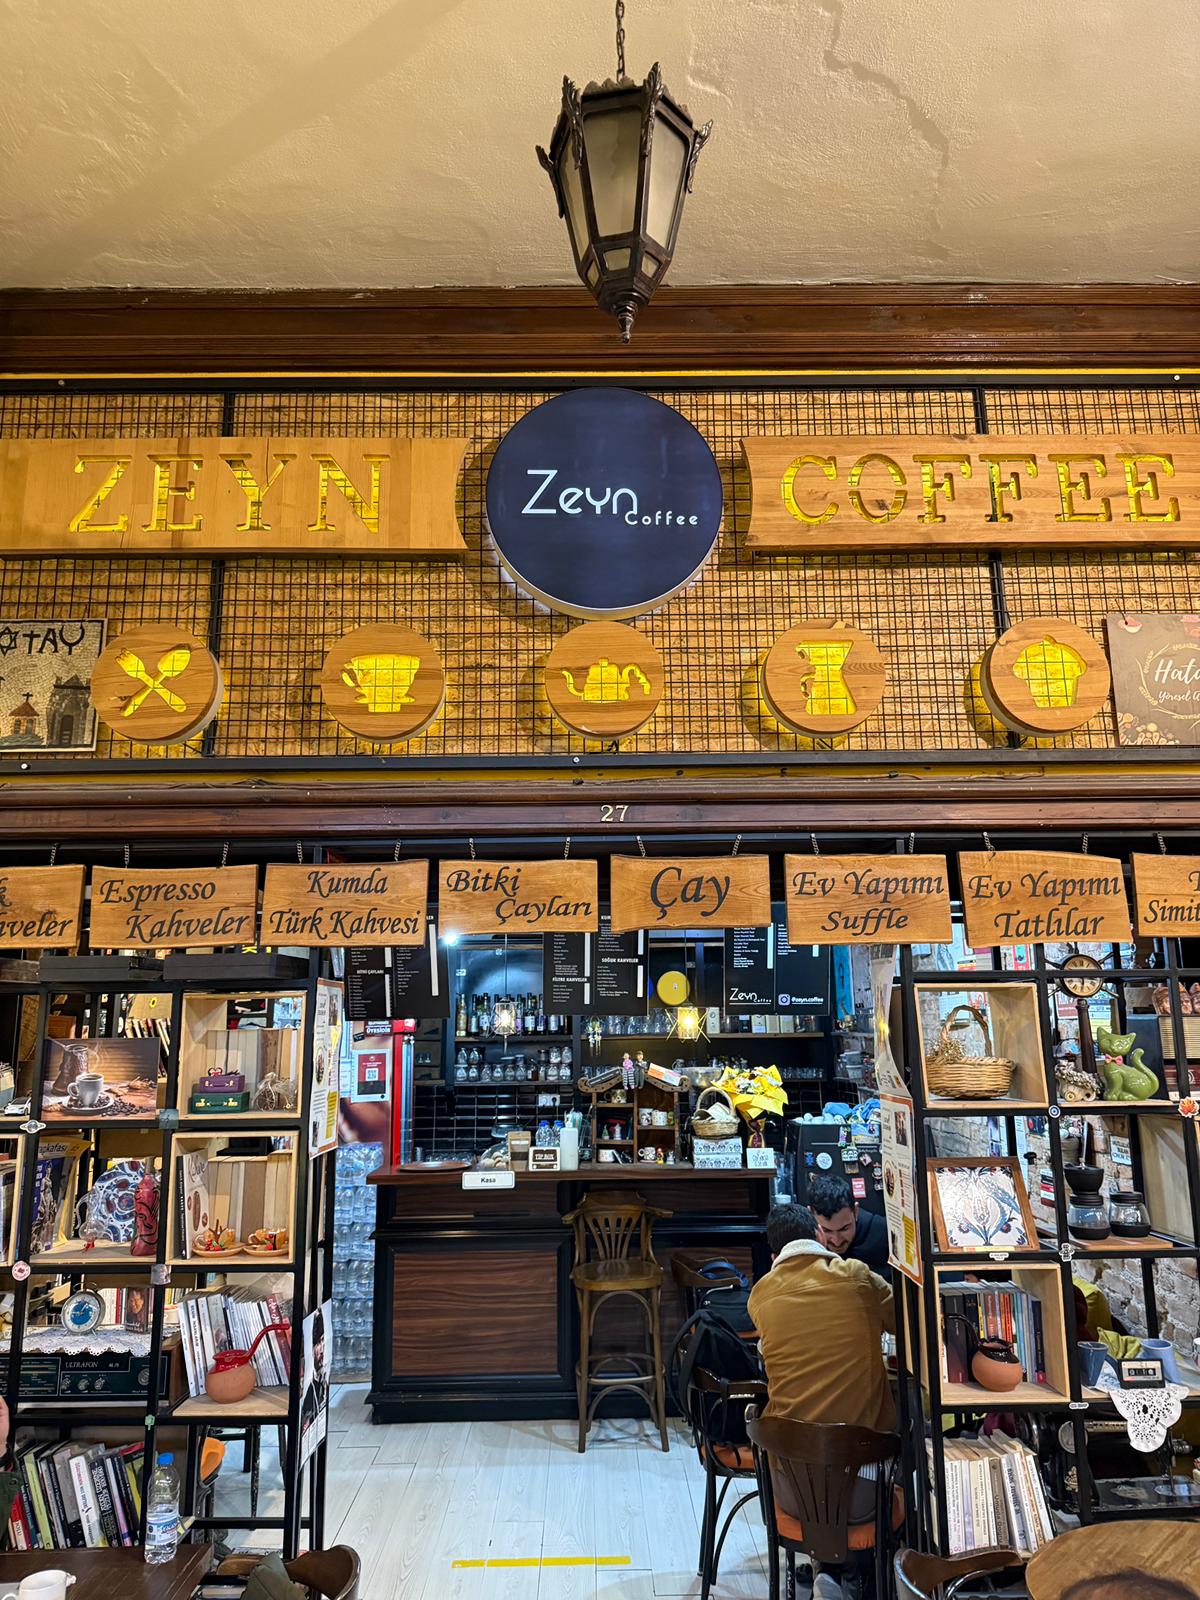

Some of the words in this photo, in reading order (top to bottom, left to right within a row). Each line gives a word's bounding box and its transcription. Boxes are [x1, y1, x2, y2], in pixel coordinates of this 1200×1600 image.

[69, 454, 391, 533] ZEYN
[521, 469, 638, 515] Zeyn
[780, 453, 1182, 525] COFFEE
[624, 510, 699, 526] Coffee
[600, 804, 629, 822] 27
[100, 878, 217, 911] Espresso
[306, 868, 389, 898] Kumda
[446, 867, 522, 897] Bitki
[649, 866, 731, 921] Çay
[793, 871, 834, 897] Ev
[843, 867, 946, 902] Yapımı
[969, 874, 1012, 899] Ev
[1020, 872, 1121, 904] Yapımı
[126, 907, 250, 940] Kahveler
[269, 907, 327, 940] Türk
[328, 907, 420, 938] Kahvesi
[494, 895, 592, 925] Çayları
[821, 908, 909, 937] Suffle
[993, 907, 1105, 940] Tatlılar
[729, 987, 758, 1001] Zeyn
